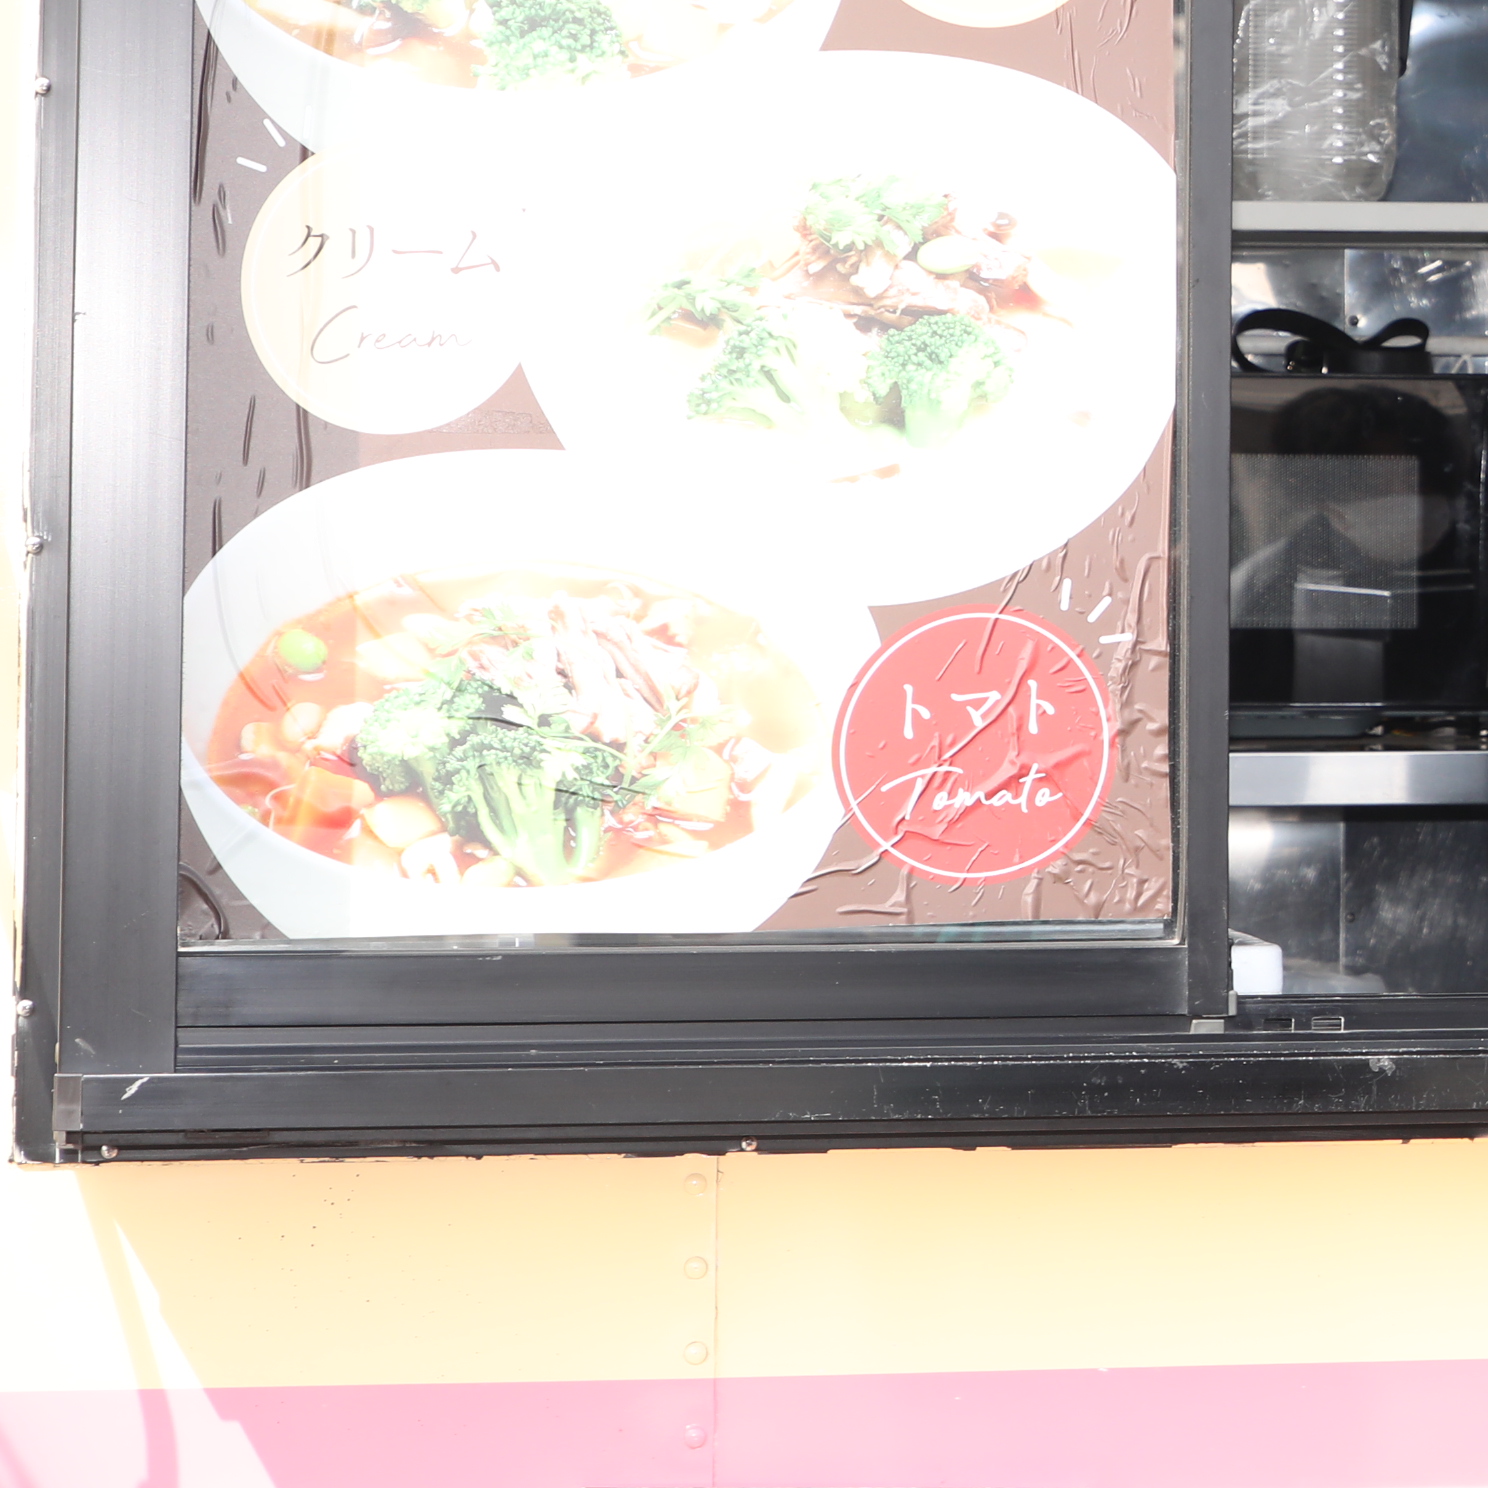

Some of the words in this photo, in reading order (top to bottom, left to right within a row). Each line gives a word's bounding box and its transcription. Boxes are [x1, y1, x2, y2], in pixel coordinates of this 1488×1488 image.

[286, 224, 501, 279] クリーム
[309, 304, 473, 365] Cream
[901, 678, 1055, 740] トマト
[881, 763, 1063, 824] Tomato
